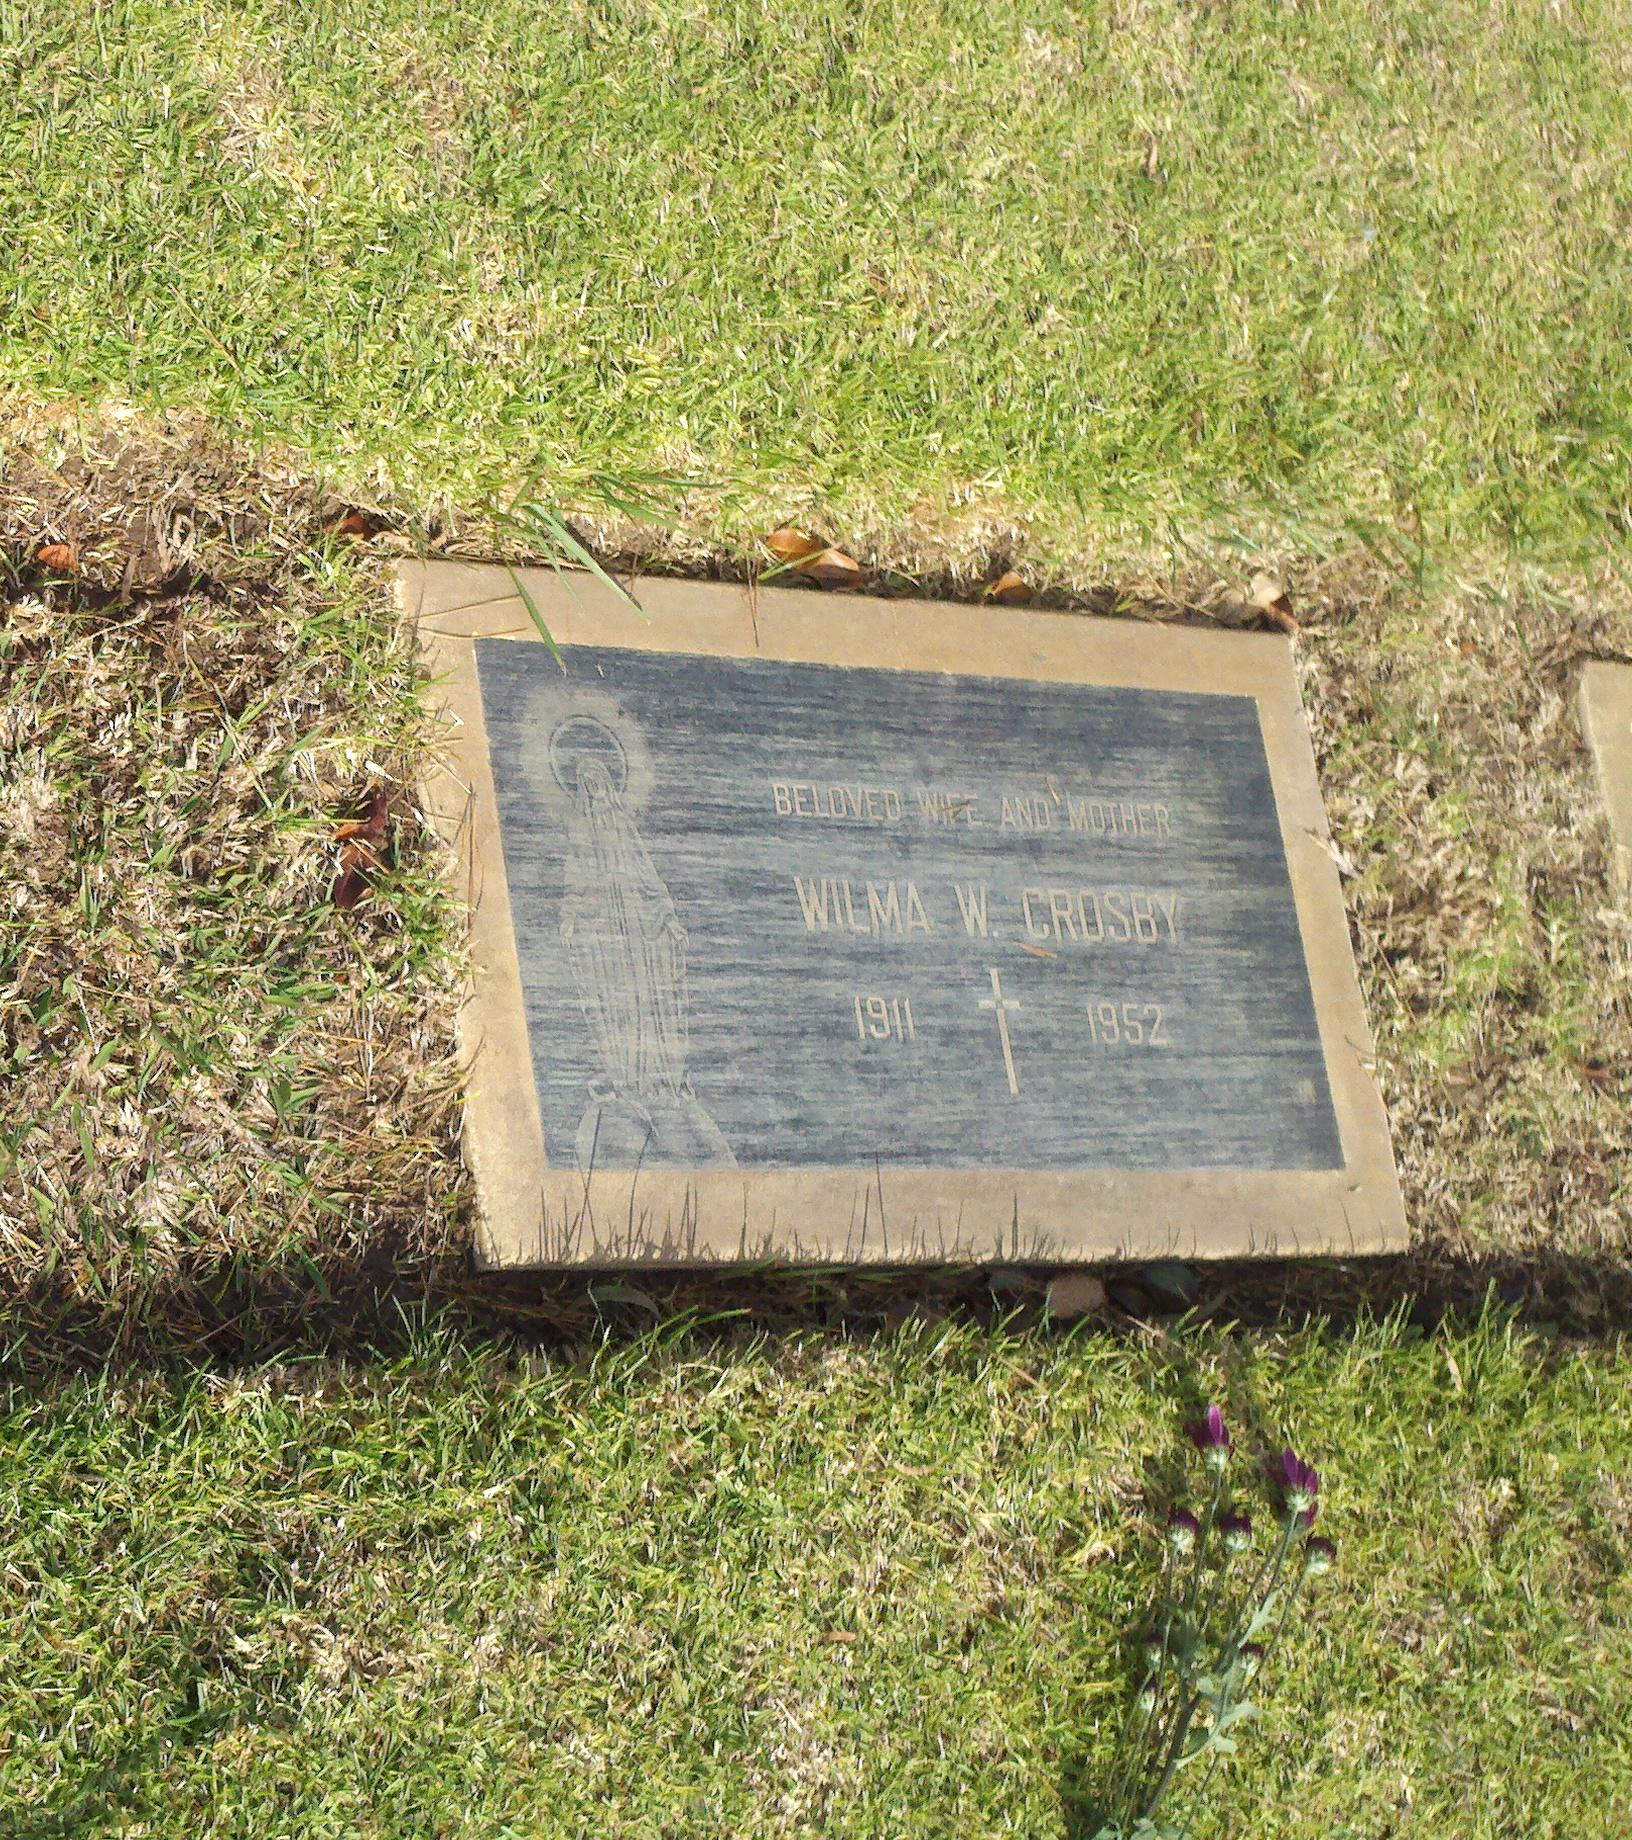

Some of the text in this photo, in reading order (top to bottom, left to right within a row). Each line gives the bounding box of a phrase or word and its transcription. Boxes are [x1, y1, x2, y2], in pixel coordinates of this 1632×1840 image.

[772, 782, 1174, 838] BELOVED WIFE AND MOTHER
[793, 875, 1180, 945] WILMA W. CROSBY
[853, 994, 1173, 1048] 1911 1952
